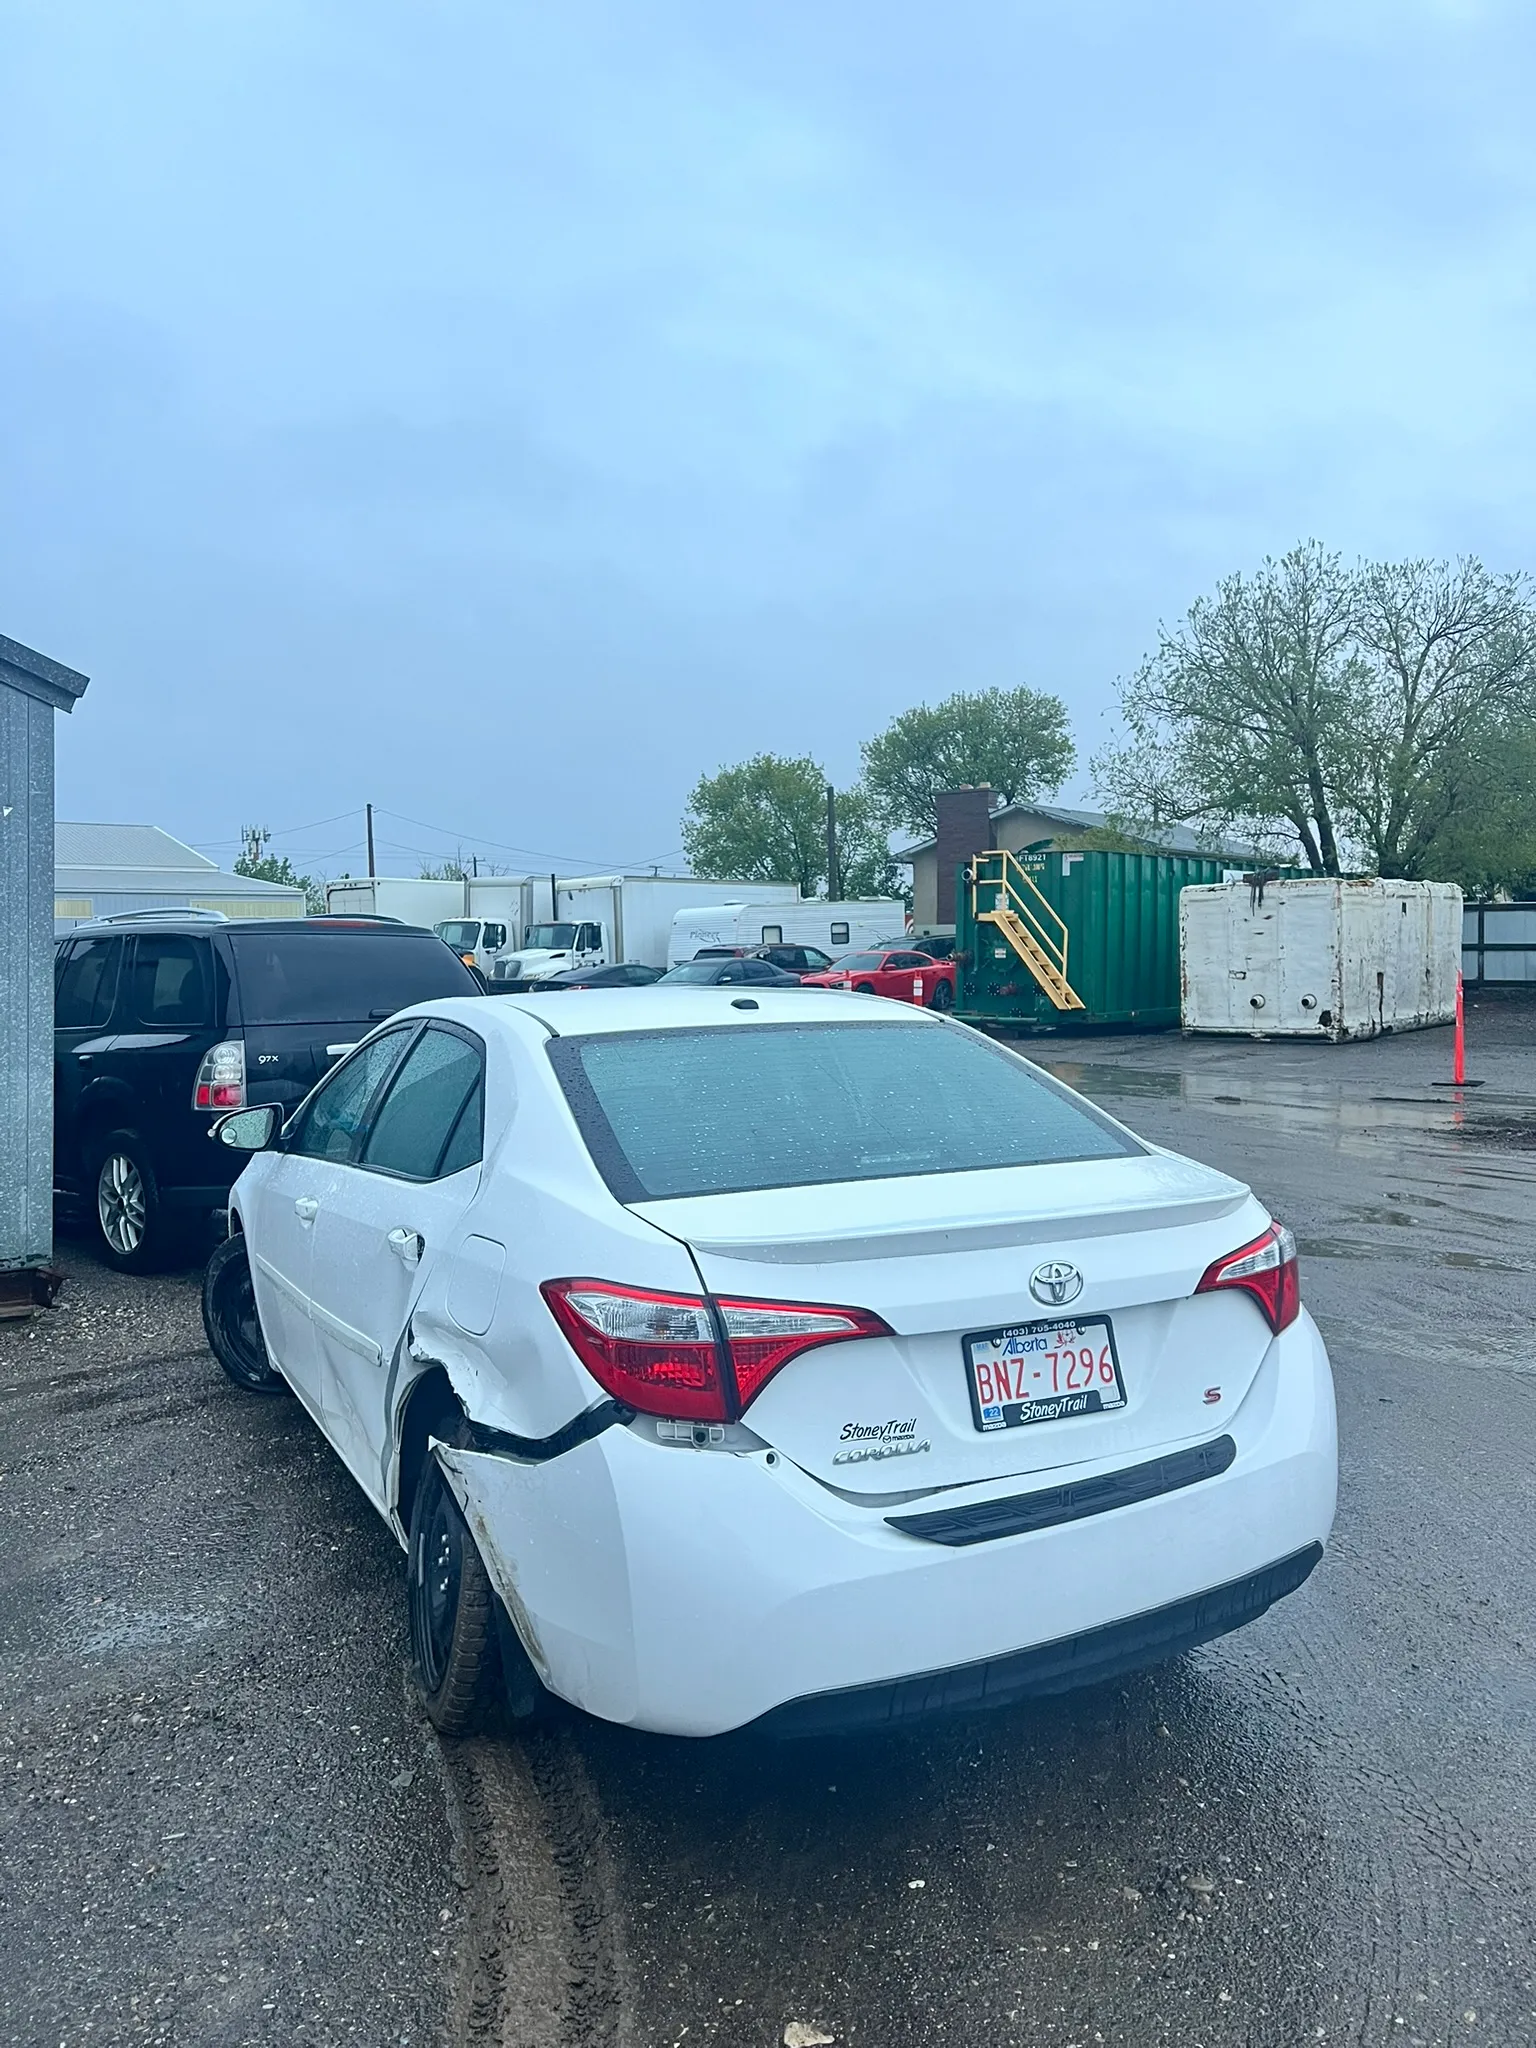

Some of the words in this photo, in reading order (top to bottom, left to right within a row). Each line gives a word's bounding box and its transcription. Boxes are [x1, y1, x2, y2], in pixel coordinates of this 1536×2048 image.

[1002, 1327, 1029, 1338] (403)
[1002, 1337, 1048, 1356] Alberta
[976, 1345, 1114, 1405] BNZ-7296
[1202, 1385, 1222, 1406] S
[989, 1407, 999, 1417] 22
[832, 1439, 931, 1466] COROLLA
